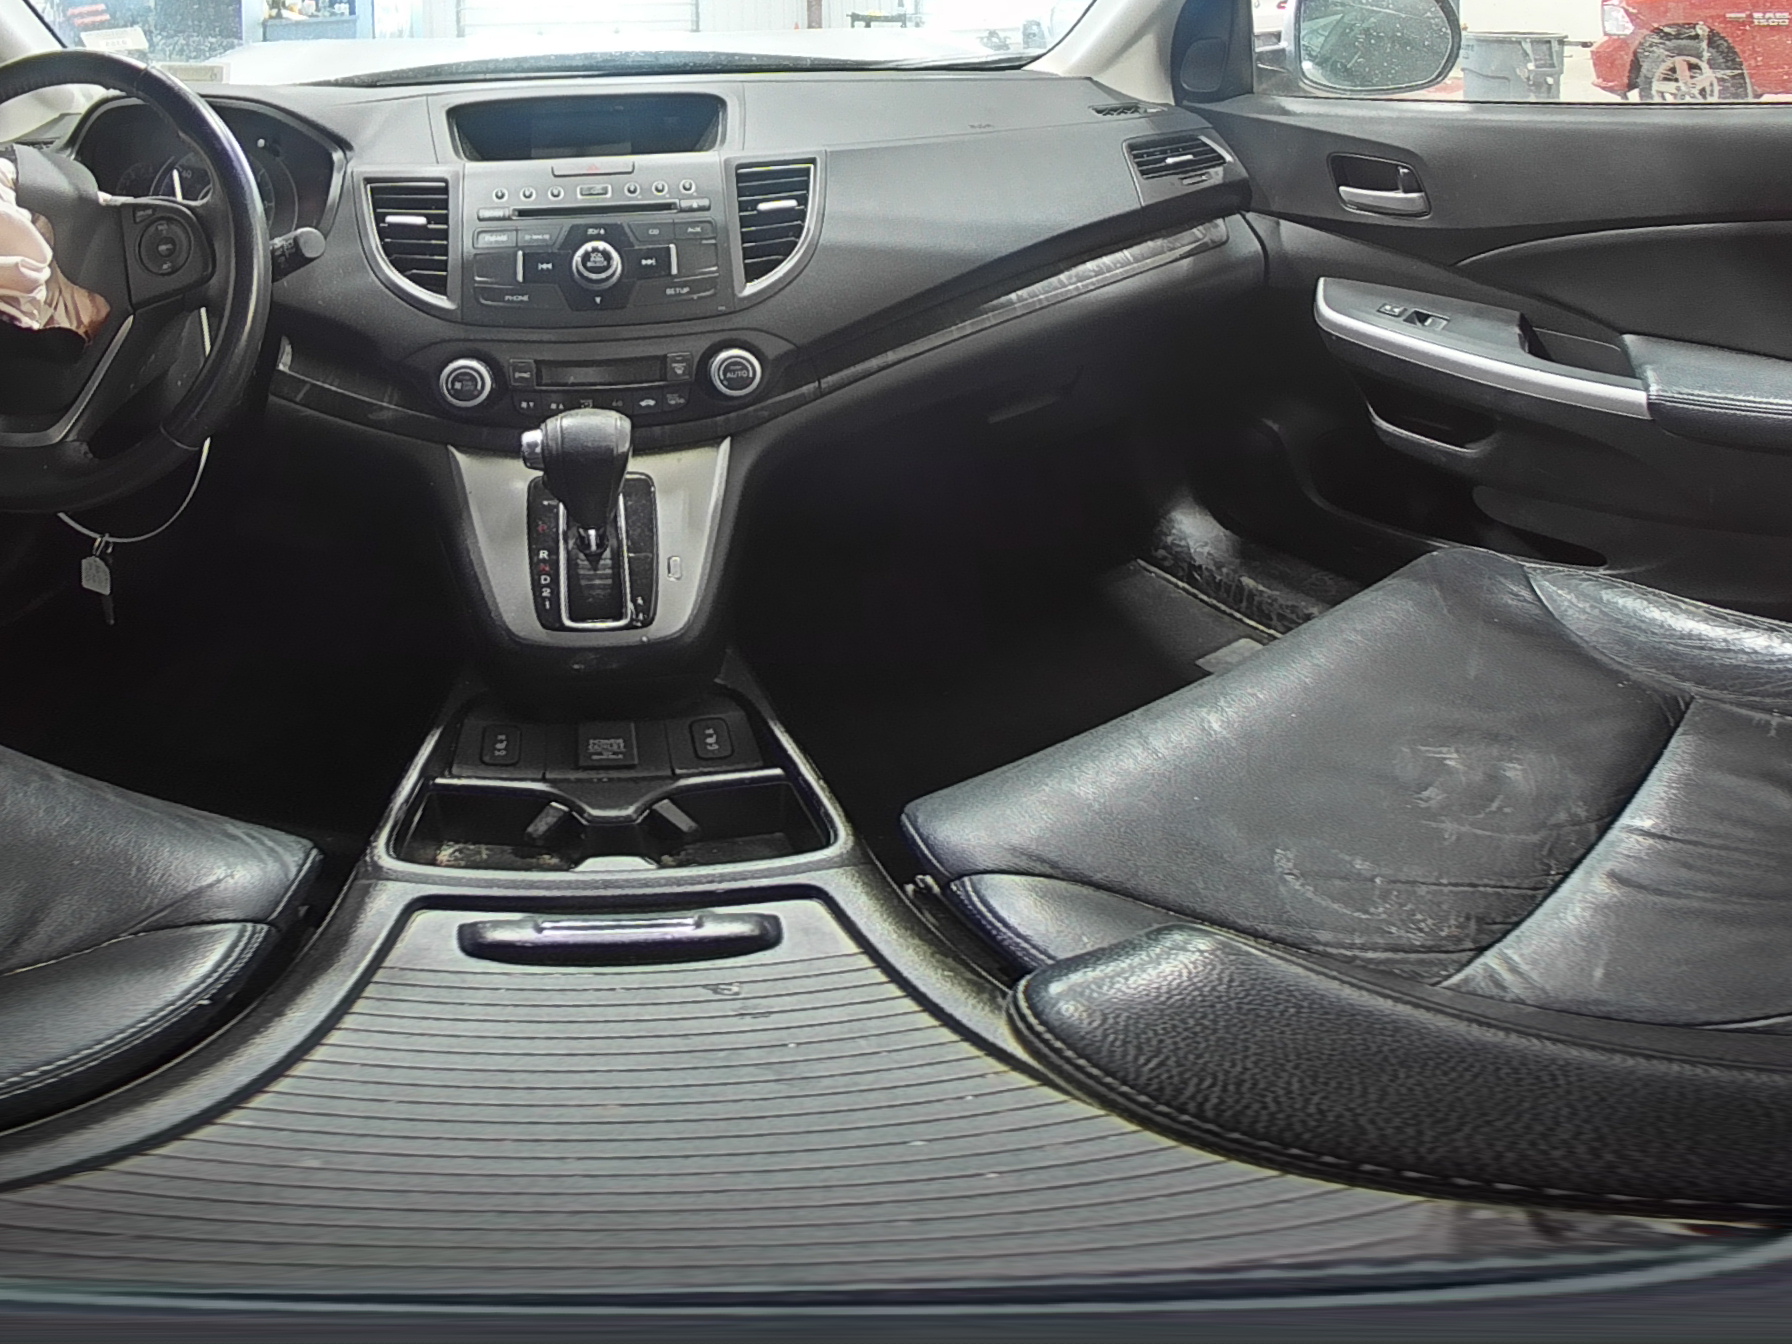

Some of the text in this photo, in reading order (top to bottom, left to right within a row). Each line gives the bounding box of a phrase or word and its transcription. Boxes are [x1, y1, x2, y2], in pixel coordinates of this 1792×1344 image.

[666, 286, 690, 295] SETUP
[504, 294, 529, 302] PHONE
[725, 369, 746, 377] AUTO
[538, 549, 549, 560] R
[540, 575, 551, 585] D
[541, 587, 551, 598] 2
[544, 598, 551, 610] 1
